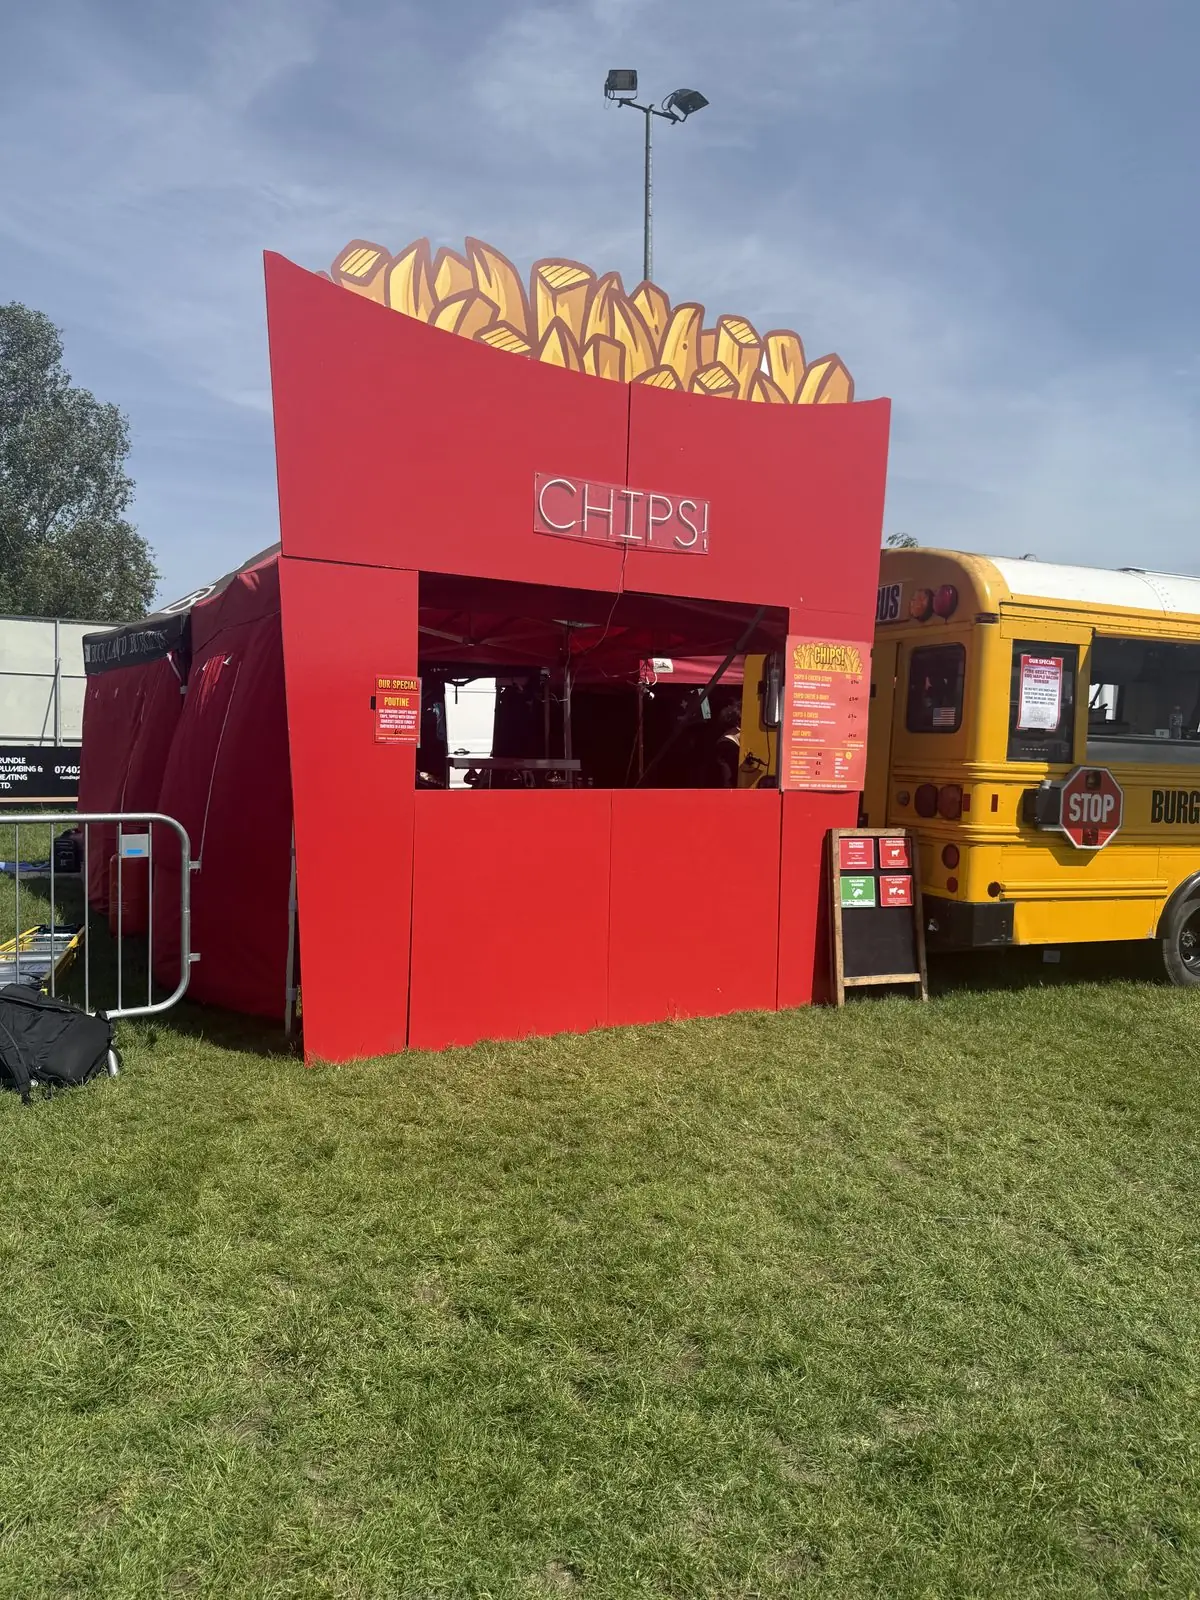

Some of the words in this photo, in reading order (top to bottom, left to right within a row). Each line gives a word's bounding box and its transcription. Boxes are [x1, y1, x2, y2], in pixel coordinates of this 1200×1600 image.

[538, 478, 709, 552] CHIPS!
[814, 646, 846, 667] CHIPS!
[378, 679, 391, 689] OUR
[392, 680, 418, 690] SPECIAL
[384, 696, 410, 707] POUTINE
[37, 765, 44, 773] &
[1069, 792, 1115, 823] STOP
[1151, 789, 1200, 824] BURG
